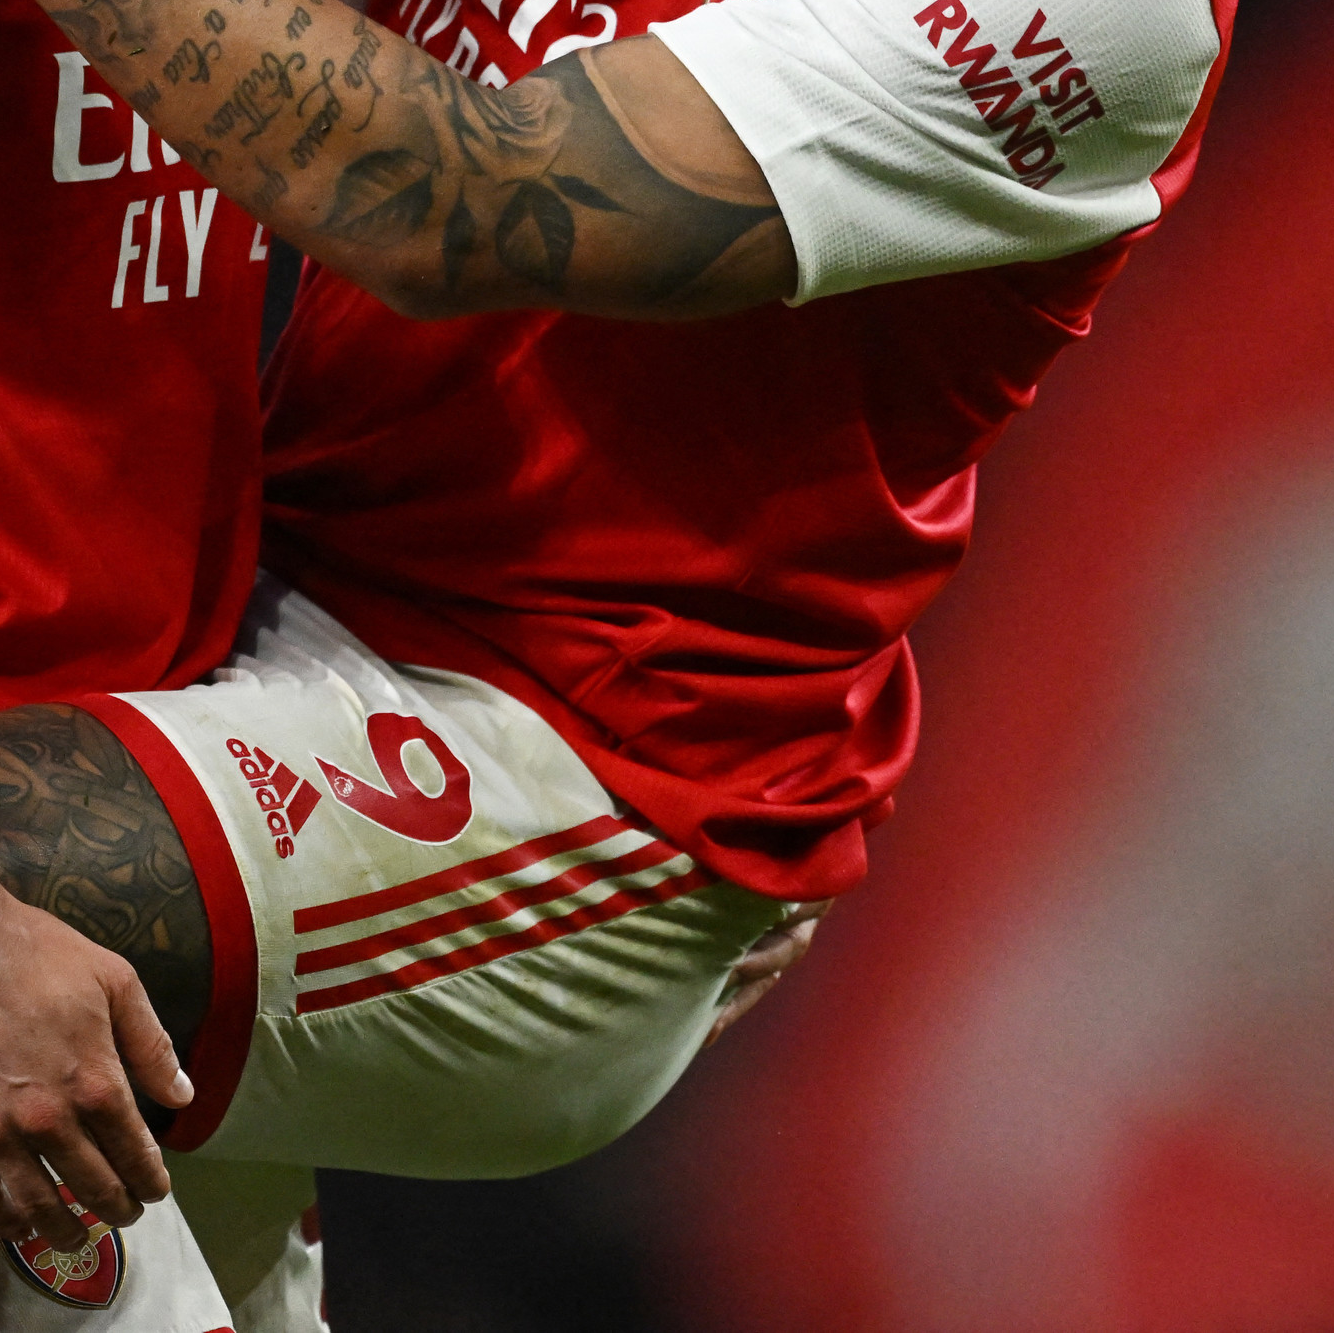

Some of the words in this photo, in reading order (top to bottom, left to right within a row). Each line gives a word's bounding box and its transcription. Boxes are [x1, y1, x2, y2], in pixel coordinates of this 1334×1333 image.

[1012, 8, 1105, 135] VISIT
[111, 187, 219, 309] FLY
[226, 738, 294, 859] adidas
[311, 712, 472, 846] 9
